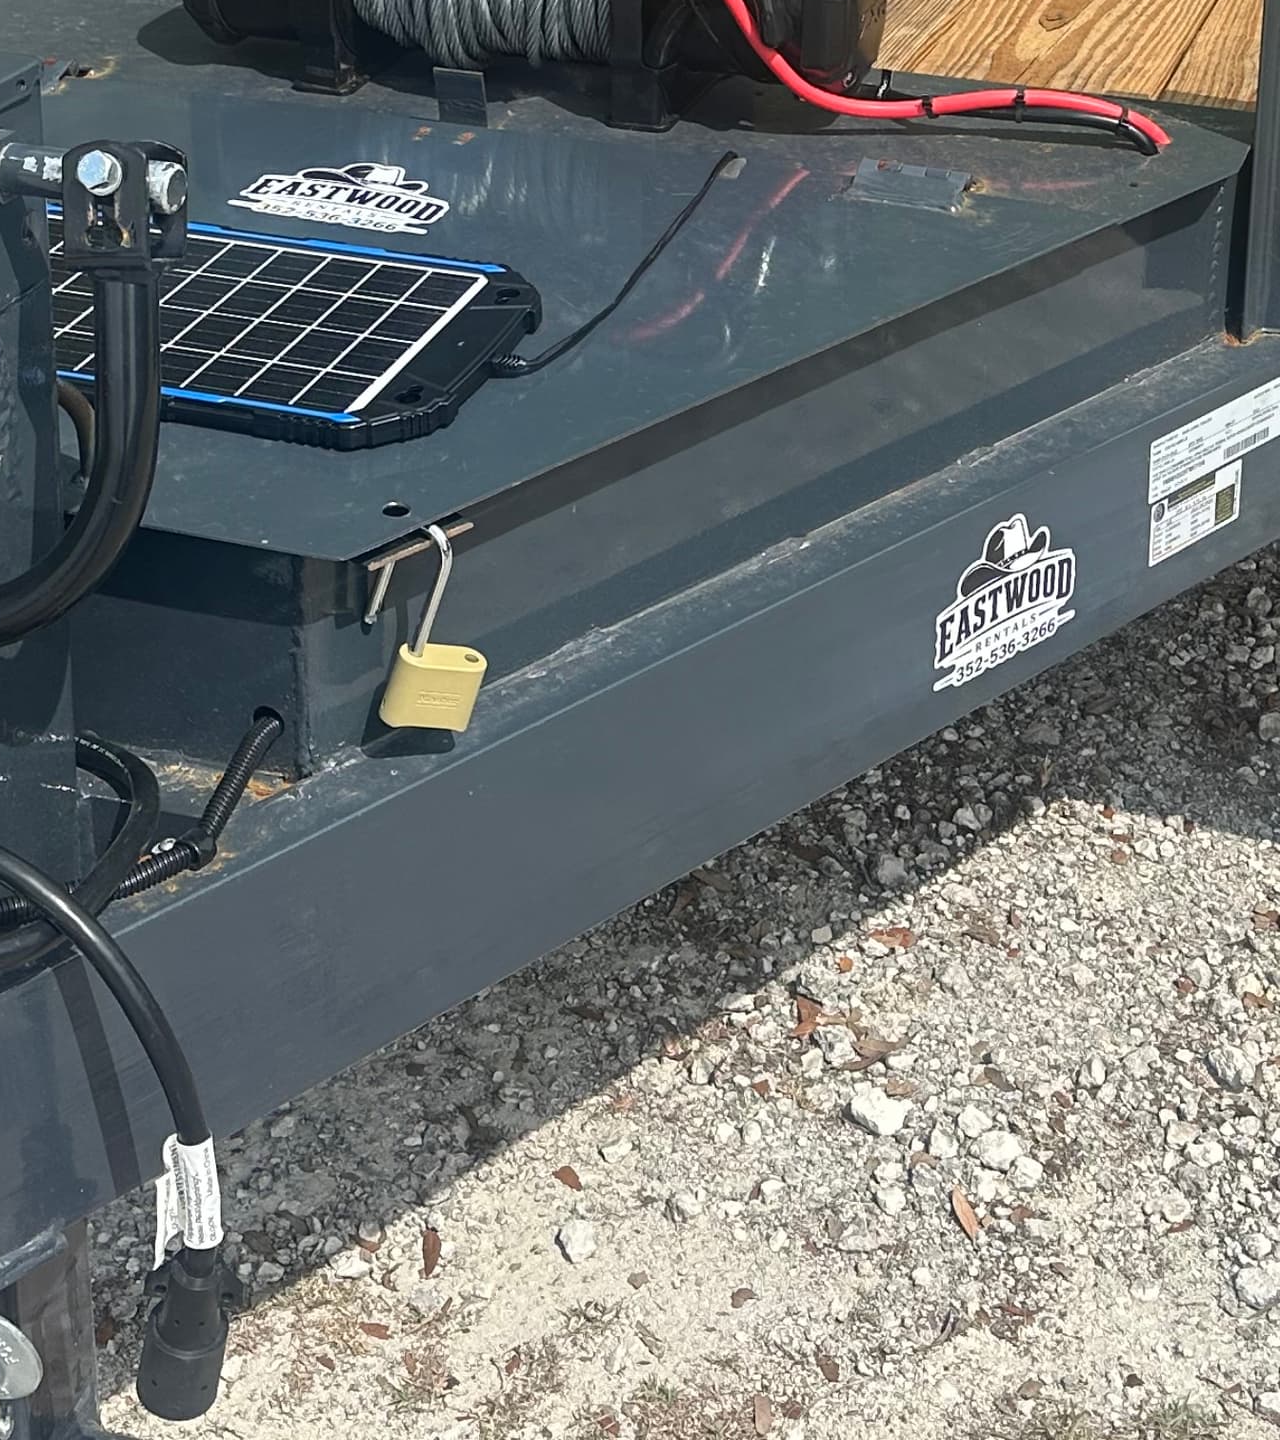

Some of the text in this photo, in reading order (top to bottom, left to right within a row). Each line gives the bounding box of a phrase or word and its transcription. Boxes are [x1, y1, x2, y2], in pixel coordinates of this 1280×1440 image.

[249, 178, 445, 222] EASTWOOD
[261, 202, 397, 231] 352-536-3266
[938, 557, 1072, 664] EASTWOOD
[975, 612, 1037, 653] RENTALS
[955, 617, 1056, 683] 352-536-3266
